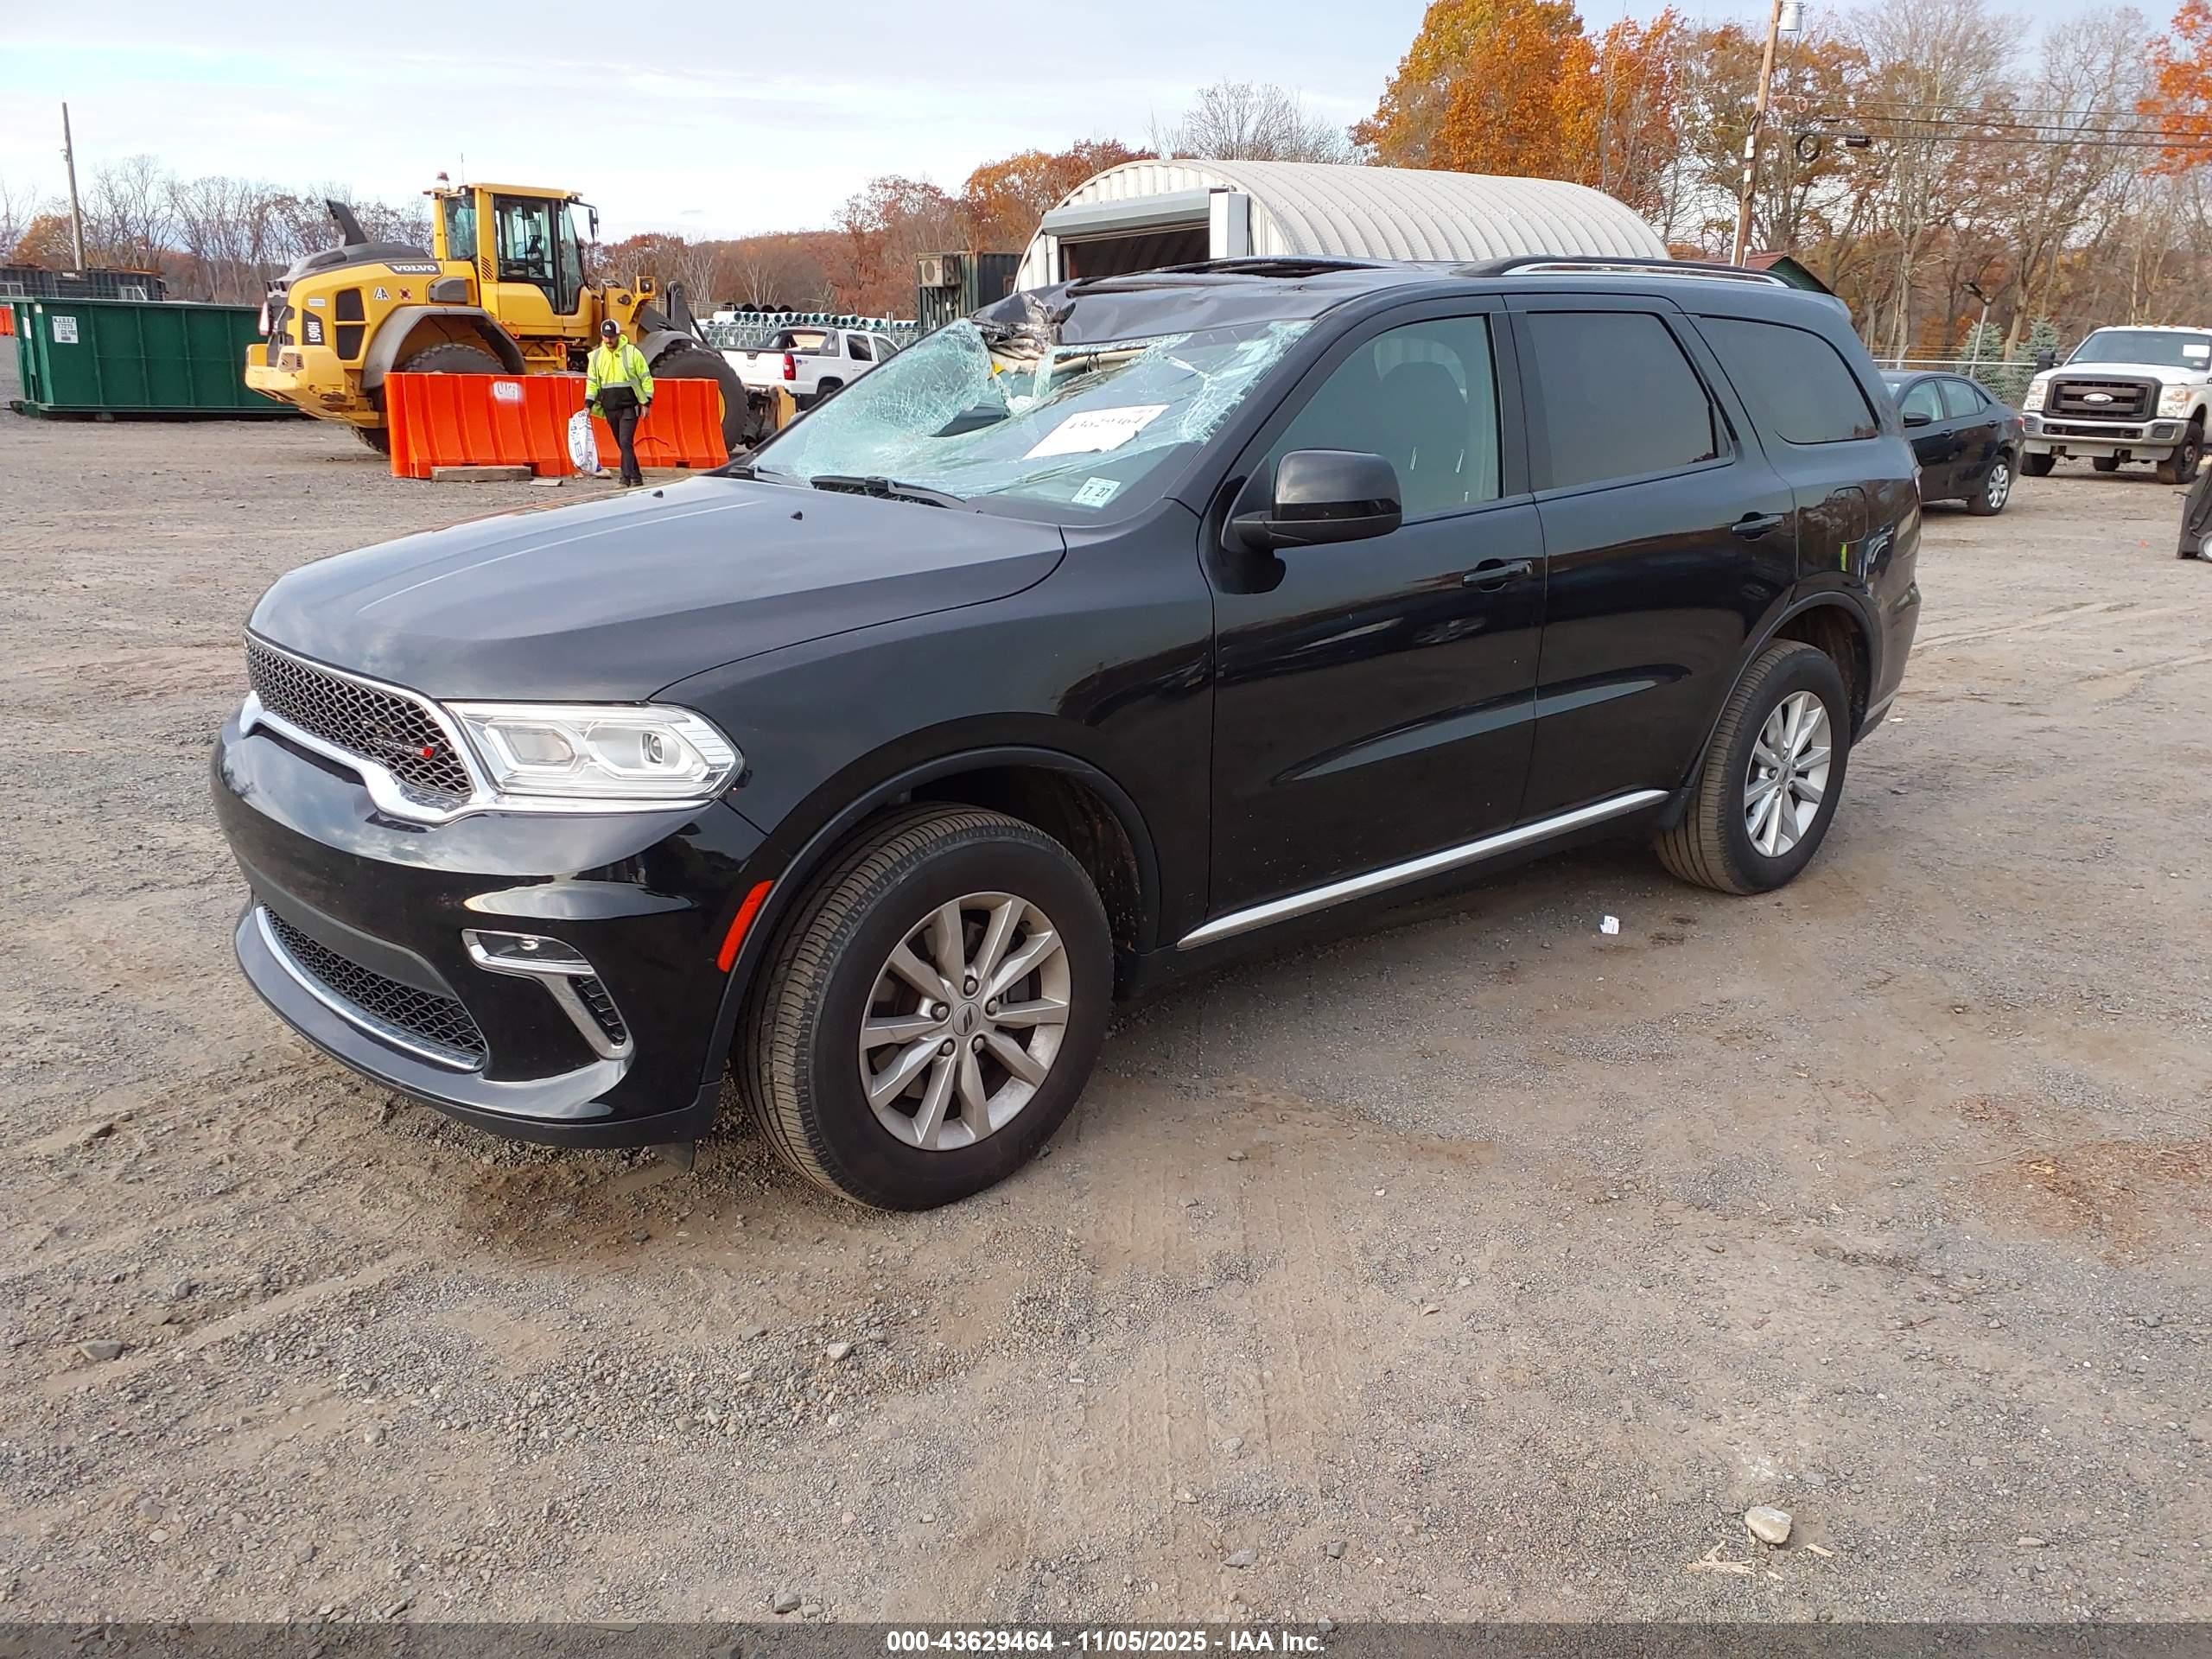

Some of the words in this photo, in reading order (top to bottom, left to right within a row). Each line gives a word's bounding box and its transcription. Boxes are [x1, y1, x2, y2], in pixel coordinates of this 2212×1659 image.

[307, 321, 321, 342] L90H
[1084, 486, 1093, 495] 7
[1095, 486, 1110, 498] 27
[372, 737, 424, 756] DODGE
